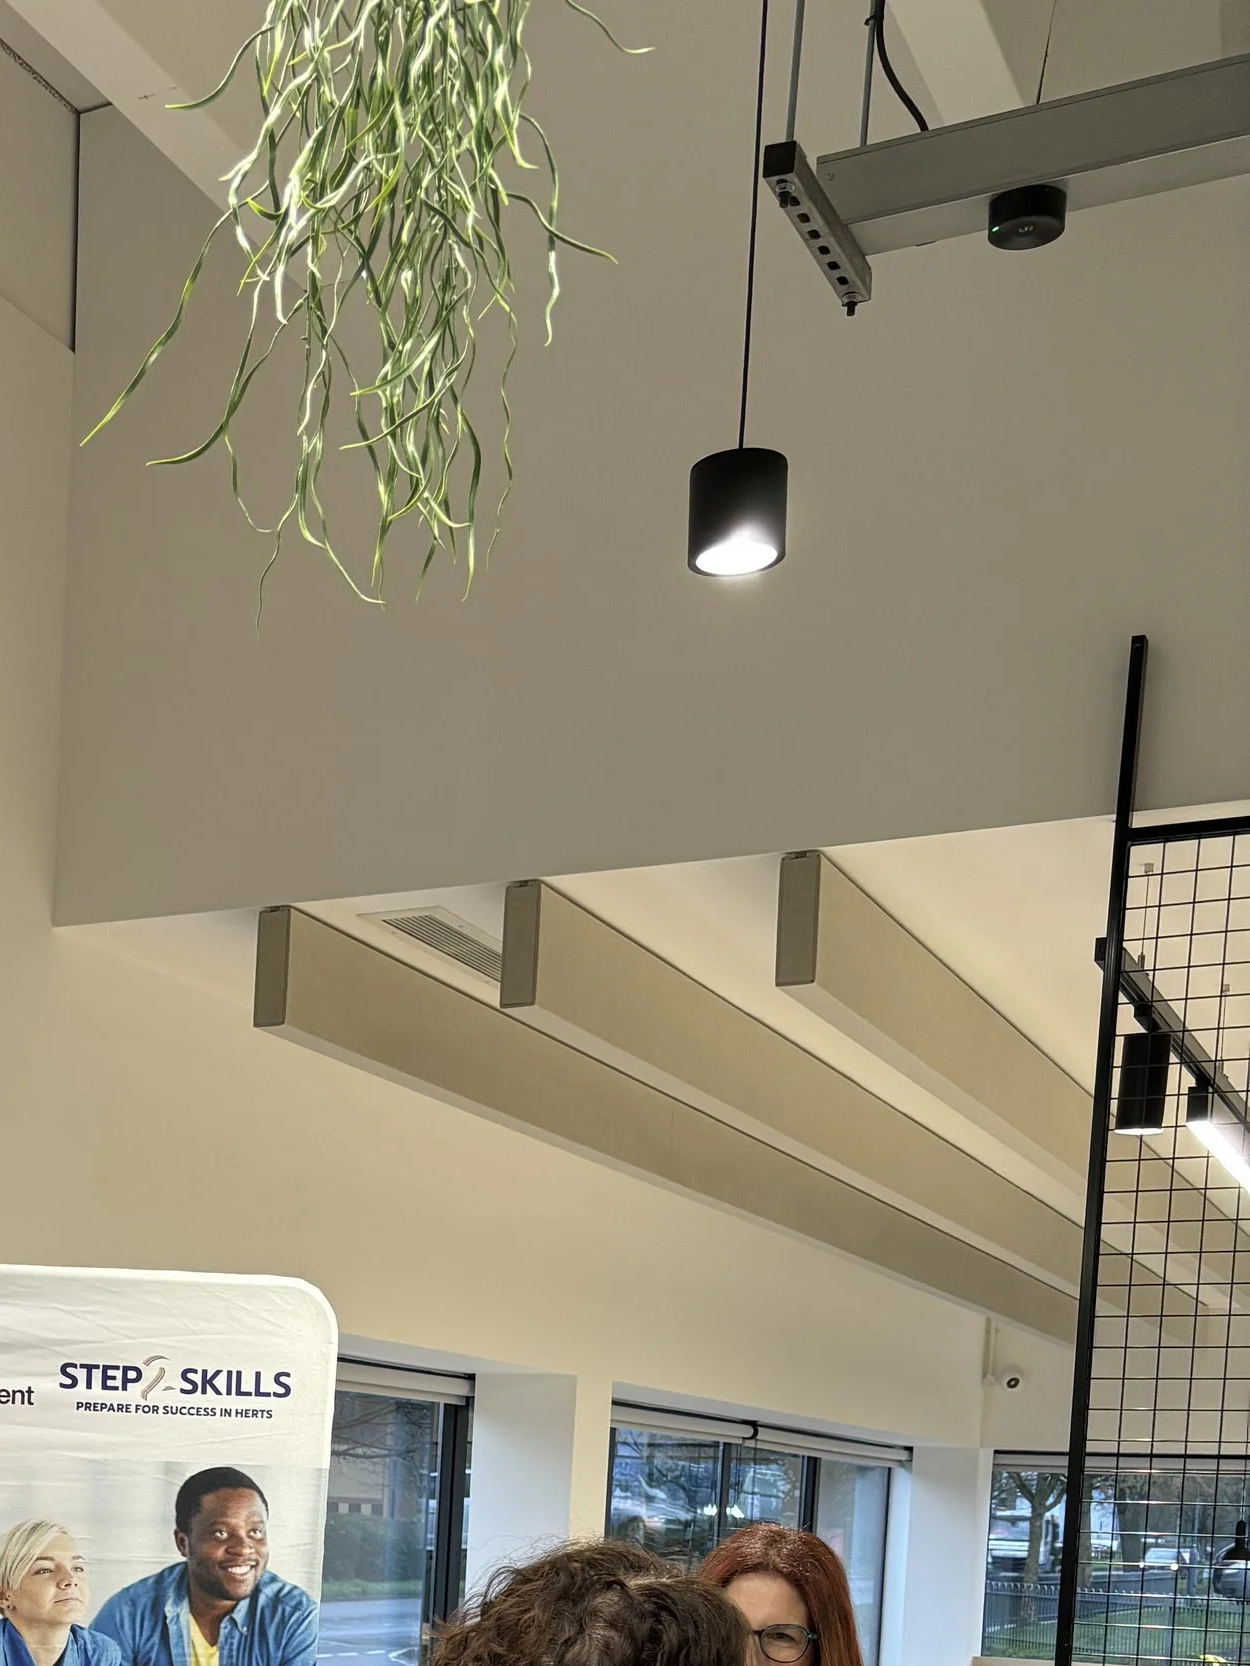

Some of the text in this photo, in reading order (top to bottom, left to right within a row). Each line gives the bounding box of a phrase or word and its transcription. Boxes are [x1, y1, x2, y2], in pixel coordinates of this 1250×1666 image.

[180, 1368, 292, 1398] SKILLS
[76, 1401, 273, 1419] PREPARE FOR SUCCESS IN HERTS
